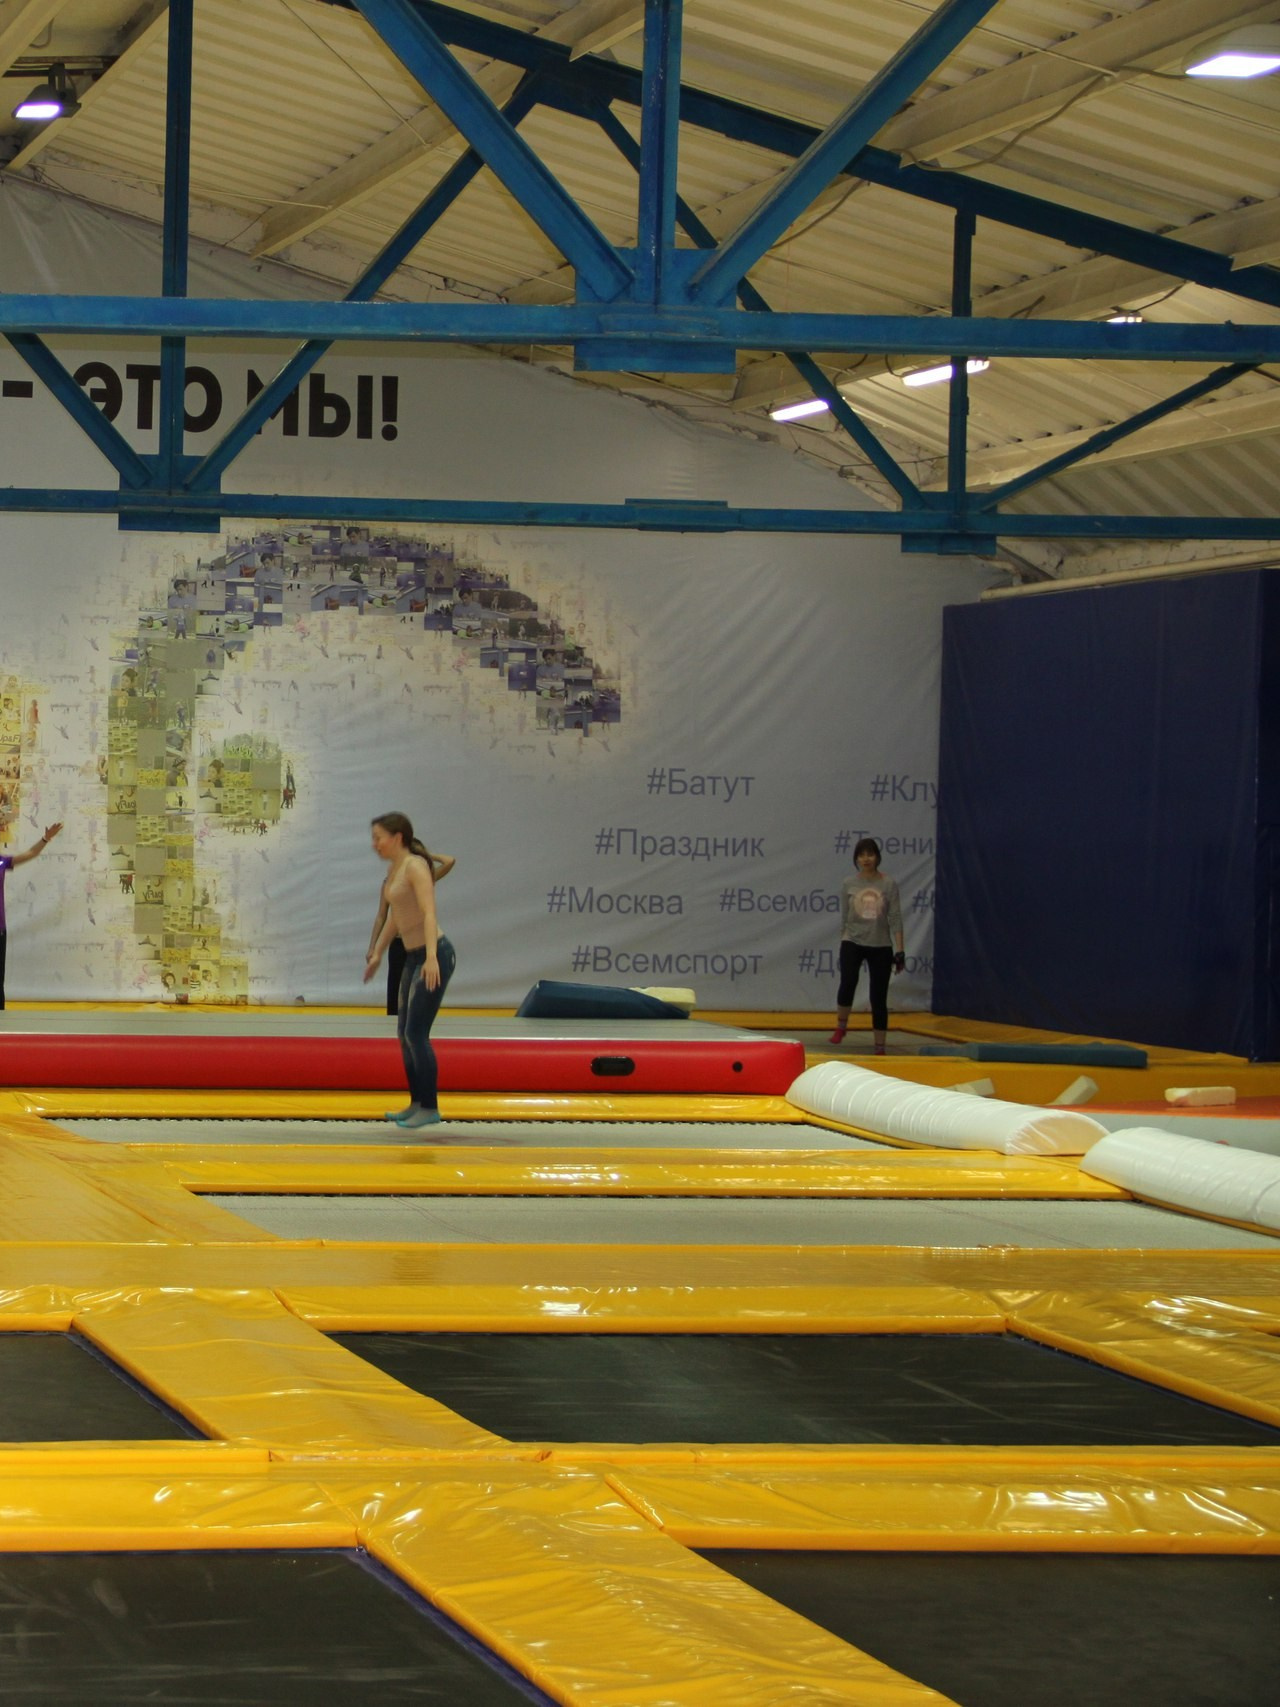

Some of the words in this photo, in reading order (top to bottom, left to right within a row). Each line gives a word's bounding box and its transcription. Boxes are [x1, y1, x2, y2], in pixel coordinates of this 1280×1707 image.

[646, 767, 756, 804] #Батут
[594, 827, 766, 862] #Праздник
[546, 885, 684, 916] #Москва
[719, 887, 842, 914] #Всемба
[571, 944, 764, 982] #Всемспорт
